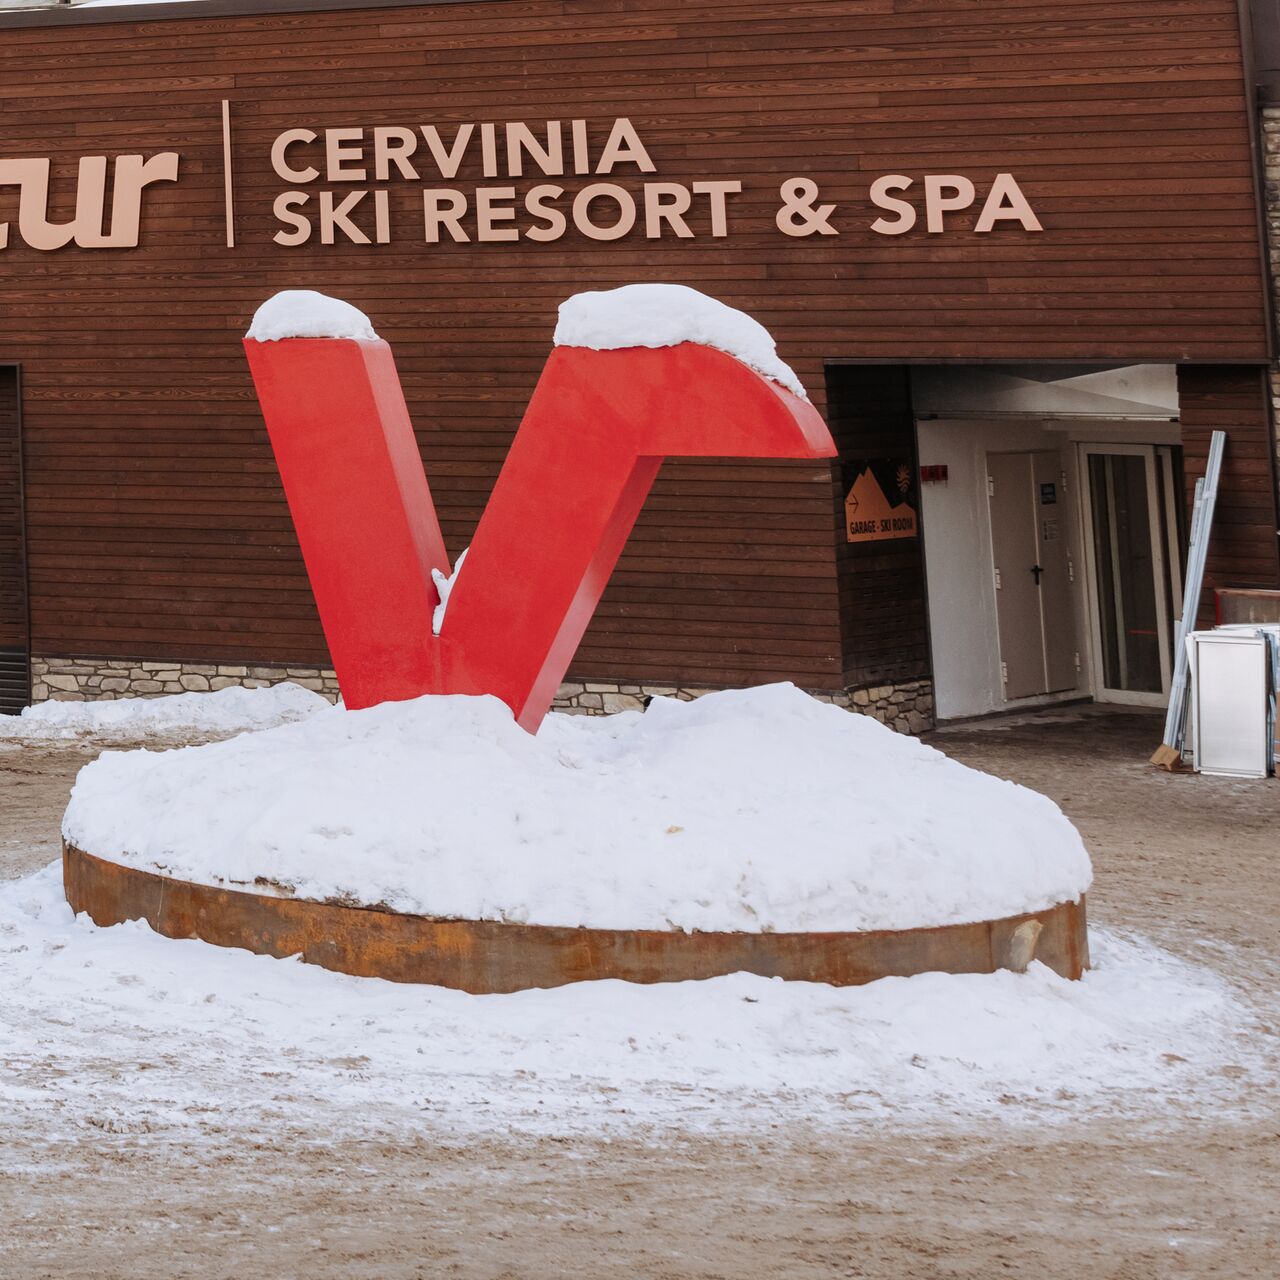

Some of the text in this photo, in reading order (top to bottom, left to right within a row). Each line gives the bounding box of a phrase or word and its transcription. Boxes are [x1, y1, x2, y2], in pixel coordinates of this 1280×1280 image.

[270, 117, 658, 184] CERVINIA
[272, 173, 1045, 246] SKI RESORT & SPA
[850, 520, 876, 535] GARAGE
[880, 519, 892, 532] SKI
[892, 517, 913, 531] ROOM
